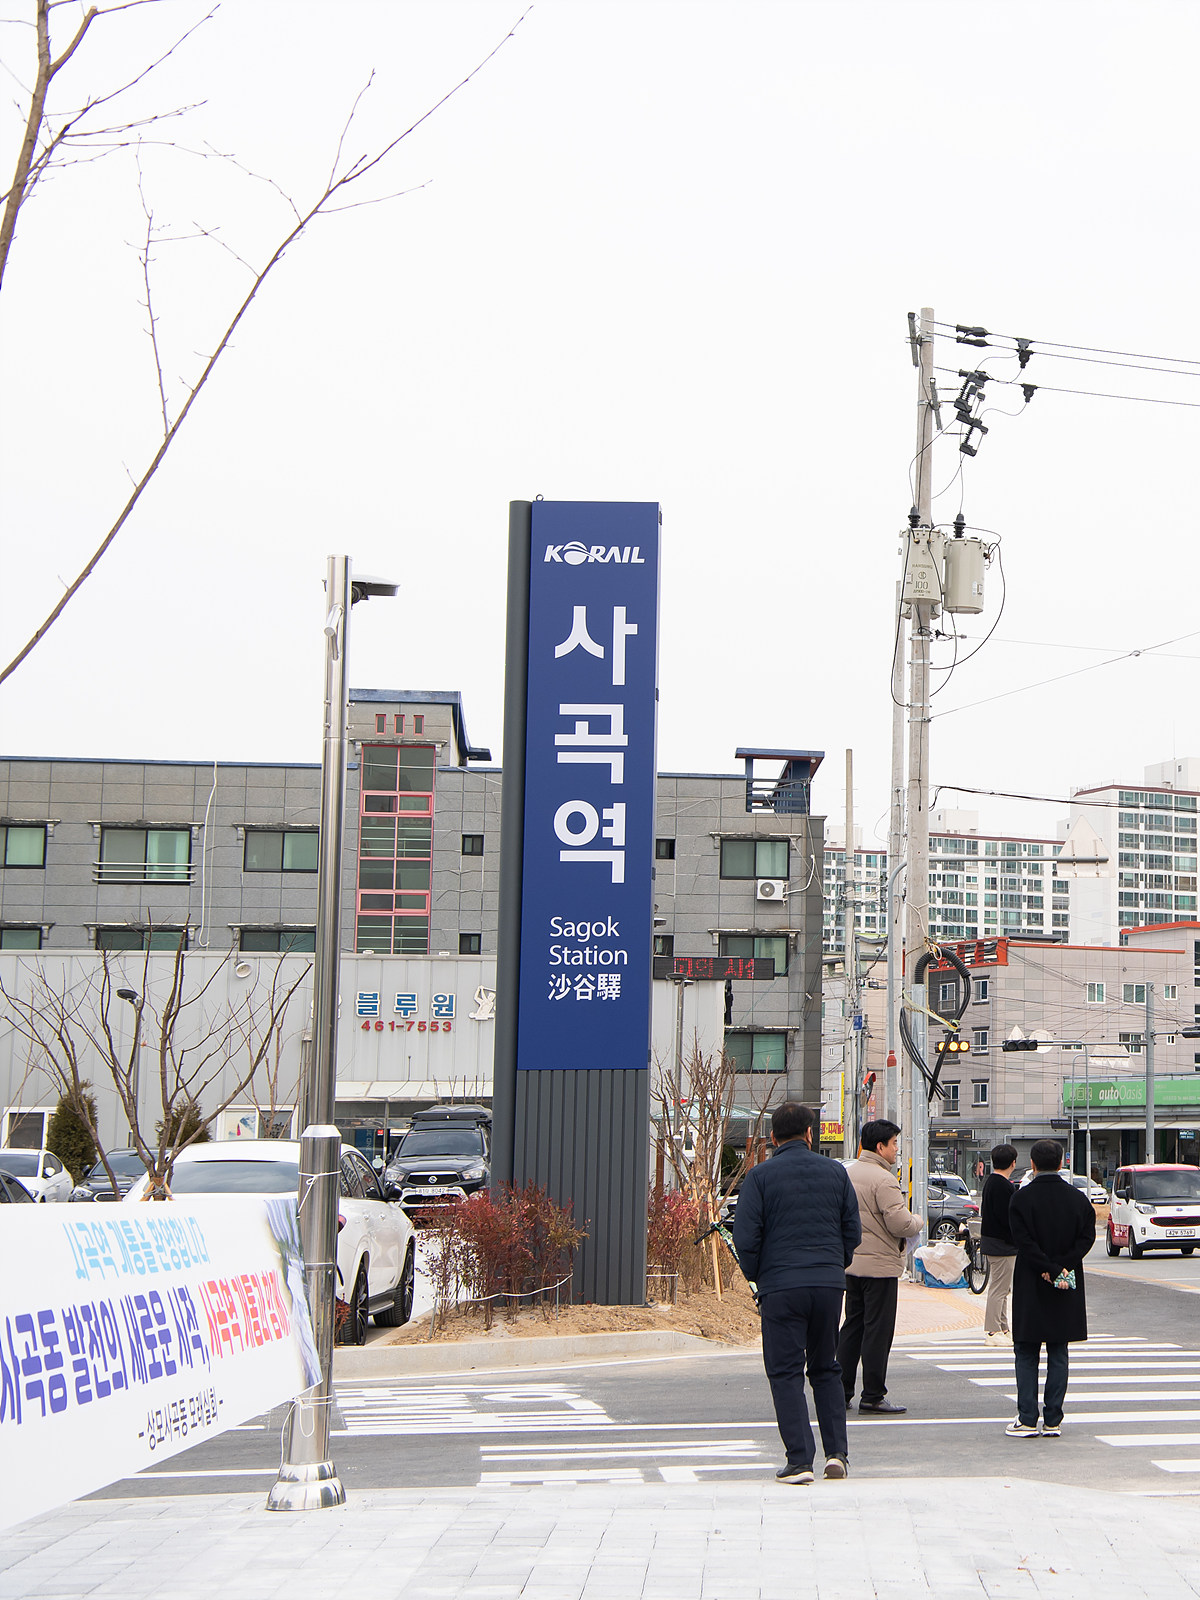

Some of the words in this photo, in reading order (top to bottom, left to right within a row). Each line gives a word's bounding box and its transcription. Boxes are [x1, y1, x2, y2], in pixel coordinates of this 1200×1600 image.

[543, 541, 645, 566] KORAIL
[553, 605, 638, 884] 사곡역
[549, 915, 620, 943] Sagok
[548, 944, 628, 966] Station
[547, 973, 621, 1001] 沙谷驛
[356, 991, 456, 1019] 블루원
[361, 1020, 452, 1032] 461-7553
[1099, 1085, 1142, 1101] autoOasis
[0, 1309, 67, 1426] 사곡동
[61, 1297, 129, 1406] 발전의
[119, 1290, 177, 1385] 새로운
